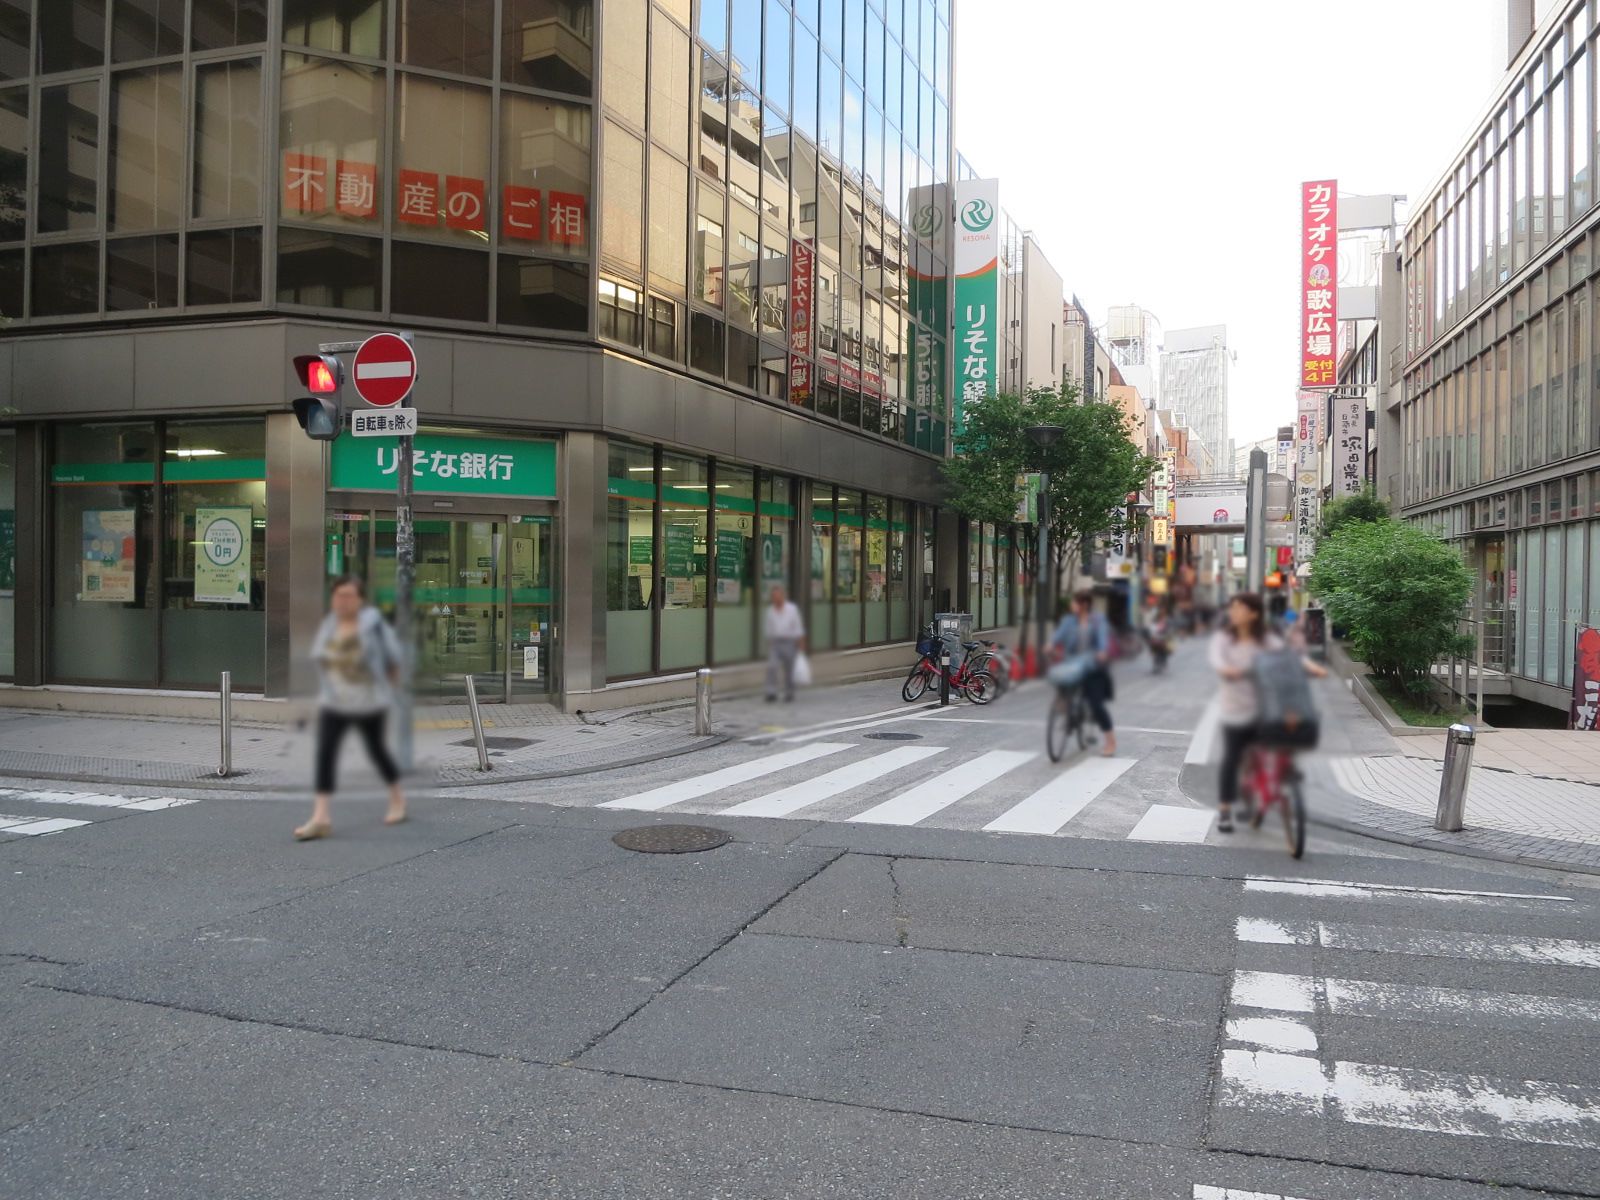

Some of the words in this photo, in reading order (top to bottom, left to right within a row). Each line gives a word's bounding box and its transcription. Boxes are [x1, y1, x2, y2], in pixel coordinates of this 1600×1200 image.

[287, 167, 584, 238] 不動産のご相
[1308, 184, 1332, 262] カラオケ
[962, 233, 991, 243] RESONA
[1306, 288, 1332, 356] 歌広場
[962, 303, 988, 429] りそな銀
[1304, 360, 1334, 371] 受付
[1305, 372, 1333, 383] 4F
[355, 415, 413, 432] 自転車を除く
[376, 447, 514, 480] りそな銀行
[214, 544, 231, 557] 0円
